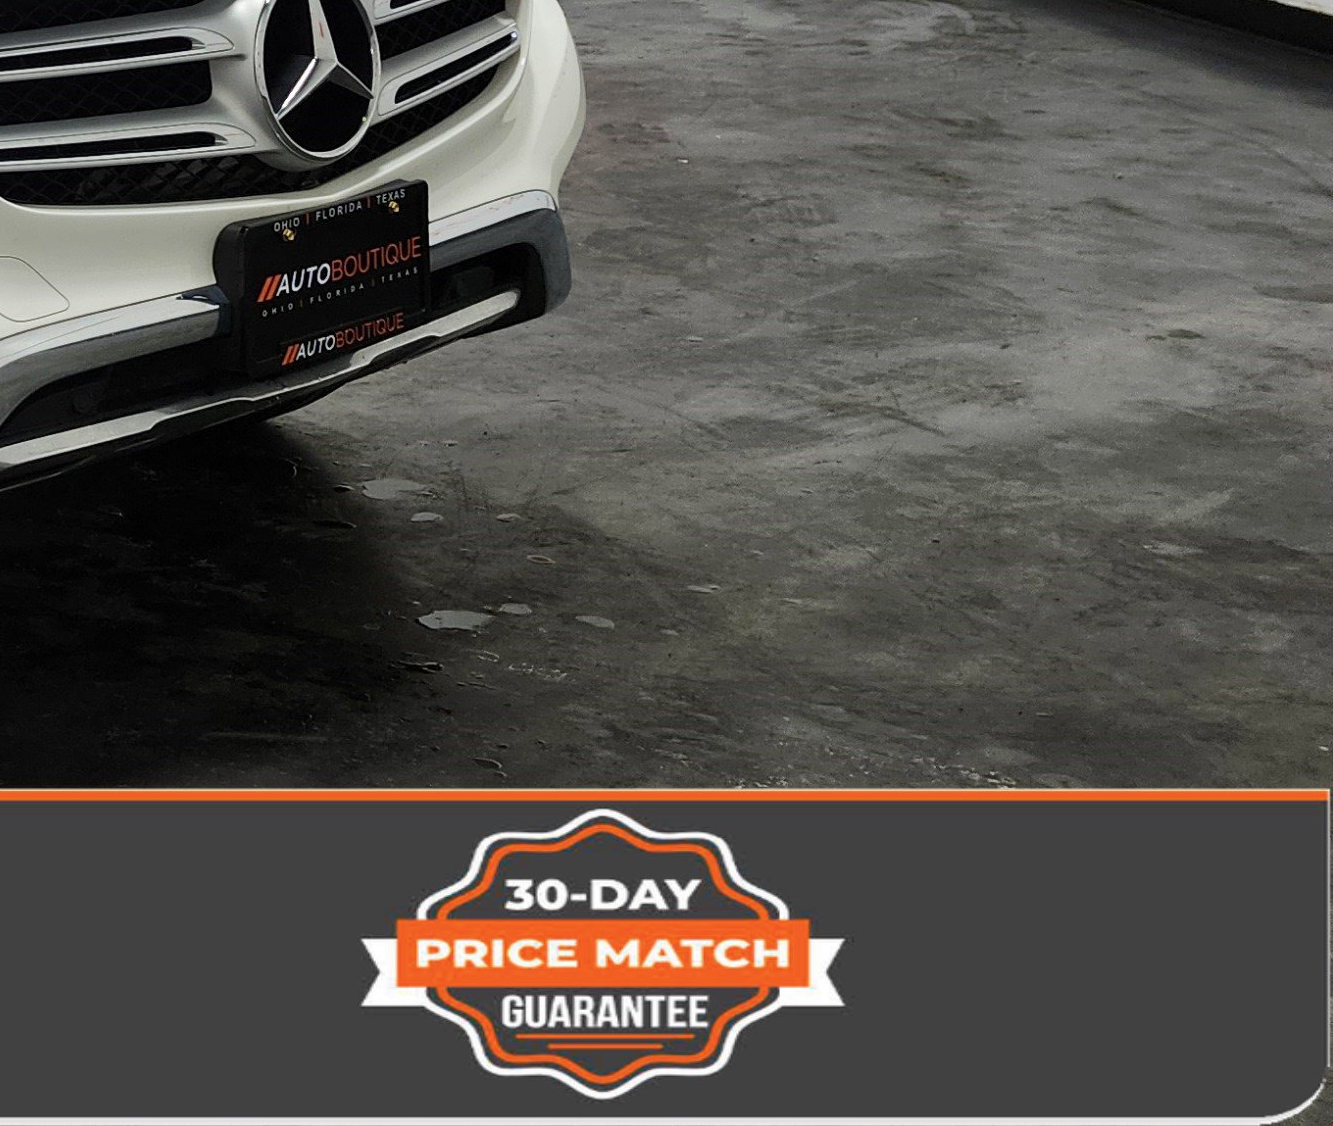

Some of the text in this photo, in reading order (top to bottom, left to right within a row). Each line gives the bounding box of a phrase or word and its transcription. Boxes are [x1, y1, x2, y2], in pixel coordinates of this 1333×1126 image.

[273, 188, 406, 233] OHIO FLORIDA TEXAS
[276, 235, 422, 297] AUTOBOUTIQUE
[261, 266, 419, 318] OHIO FLORIDA TEXAS
[295, 311, 405, 361] AUTOBOUTIQUE
